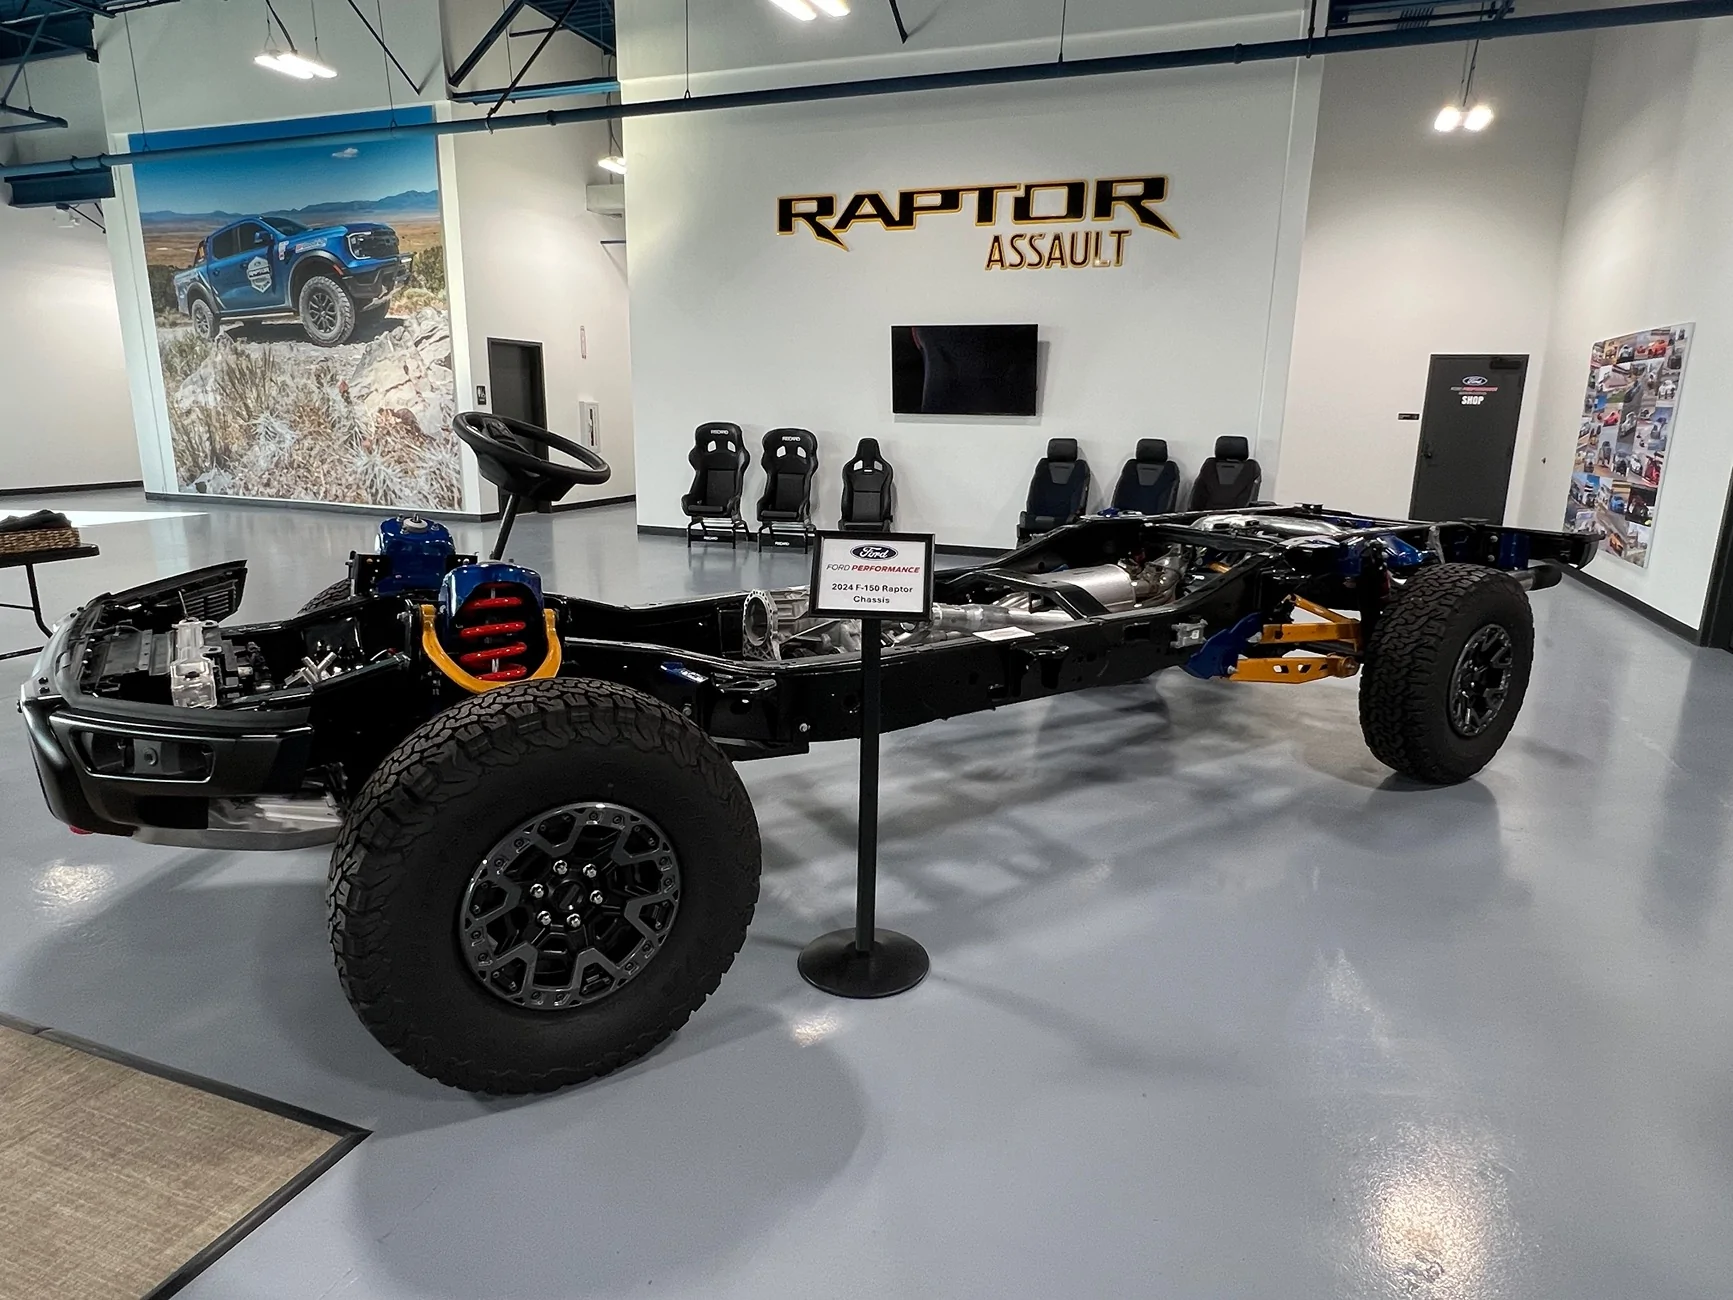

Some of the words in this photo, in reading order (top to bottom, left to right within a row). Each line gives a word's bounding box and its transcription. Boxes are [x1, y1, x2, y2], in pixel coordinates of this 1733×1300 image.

[776, 174, 1181, 252] RAPTOR
[985, 229, 1133, 271] ASSAULT
[1461, 396, 1484, 404] SHOP
[859, 547, 889, 558] Ford
[826, 563, 851, 571] FORD
[851, 564, 920, 573] PERFORMANCE
[831, 583, 854, 591] 2024
[855, 584, 880, 592] F-150
[881, 584, 914, 594] Raptor
[853, 595, 890, 604] Chassis
